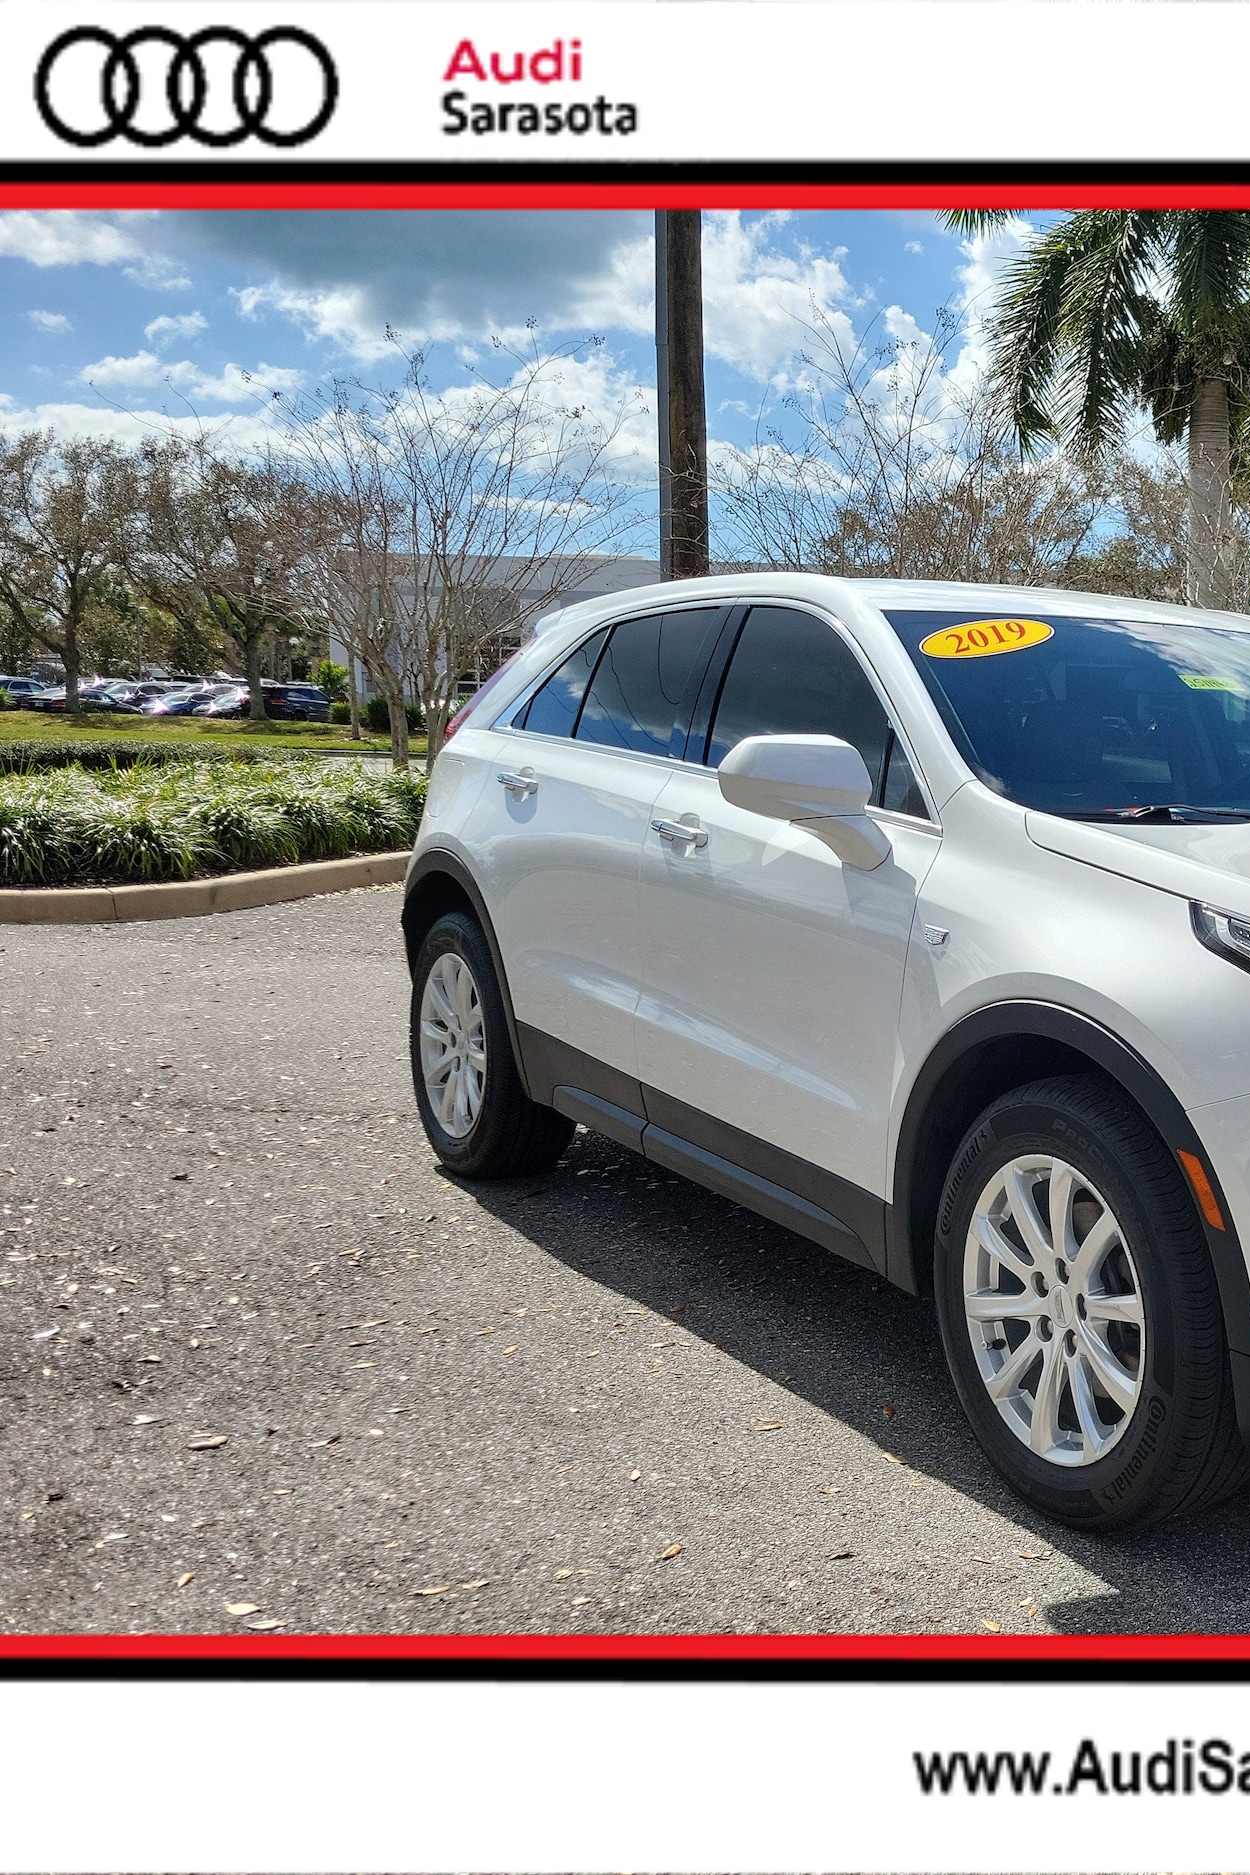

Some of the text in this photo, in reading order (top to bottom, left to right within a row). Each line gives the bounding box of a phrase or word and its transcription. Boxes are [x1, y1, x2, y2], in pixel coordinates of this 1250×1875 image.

[945, 621, 1026, 654] 2019
[940, 1137, 980, 1235] Continental
[1111, 1395, 1166, 1499] Continental
